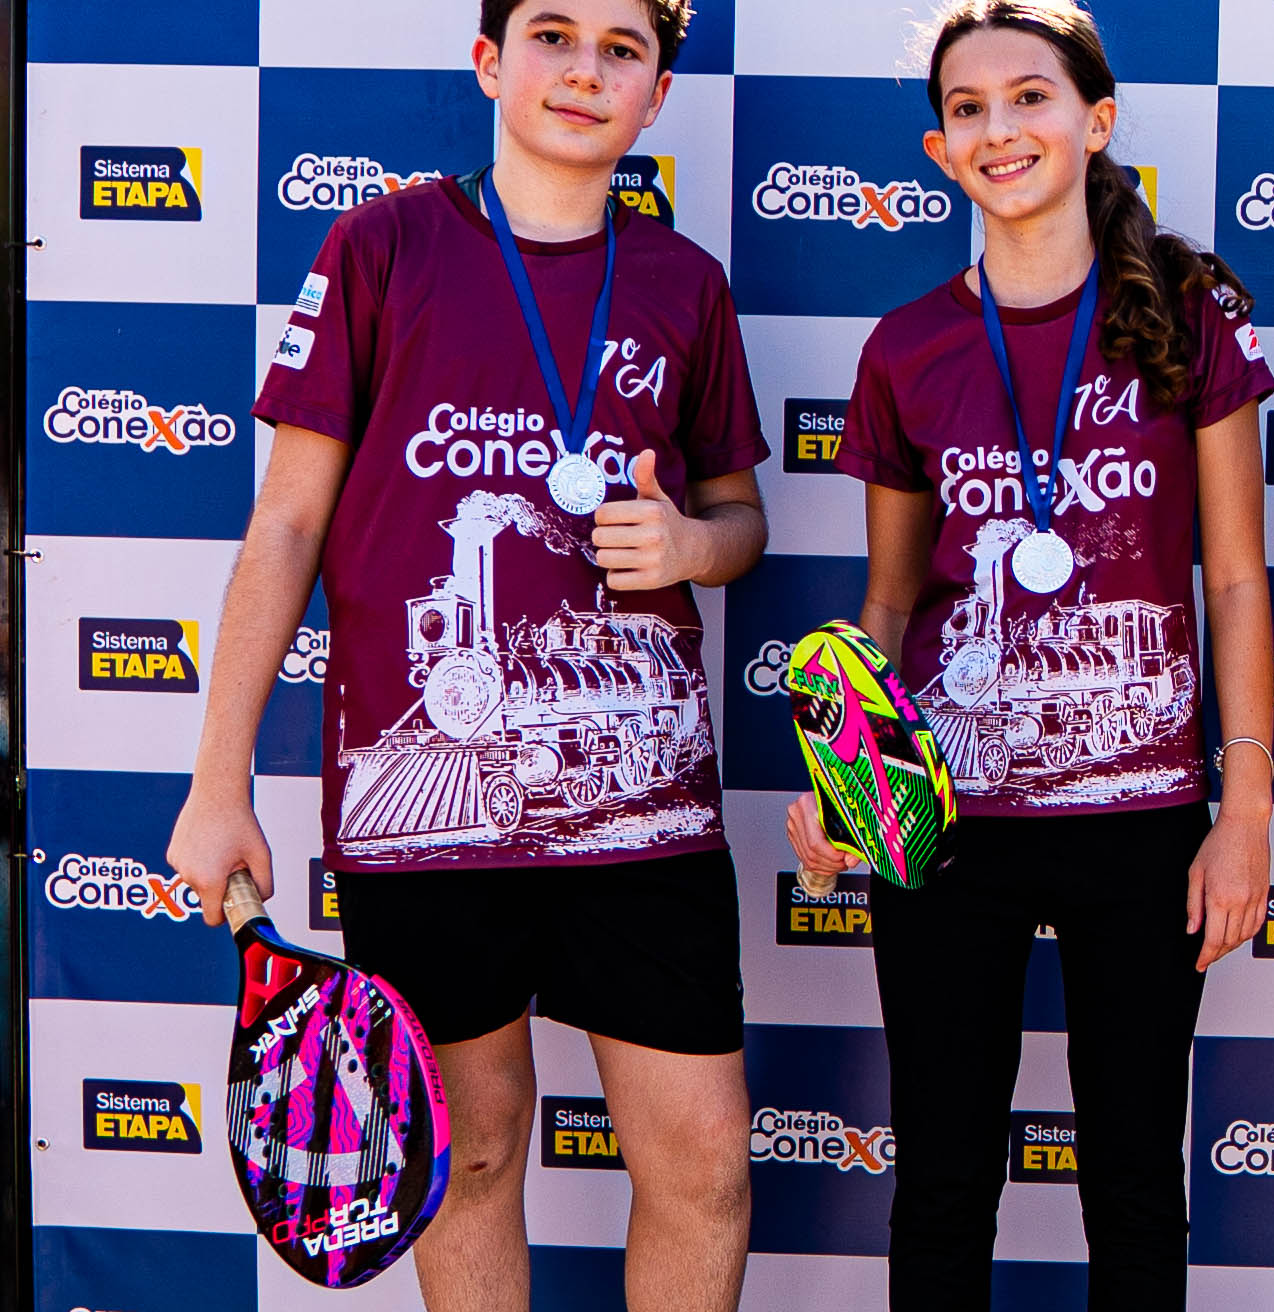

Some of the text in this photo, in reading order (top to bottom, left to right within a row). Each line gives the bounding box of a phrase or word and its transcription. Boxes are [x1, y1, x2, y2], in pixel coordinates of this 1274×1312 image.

[94, 160, 170, 178] Sistema
[297, 157, 378, 182] Colégio
[771, 165, 855, 190] Colégio
[93, 181, 188, 208] ETAPA
[282, 176, 423, 208] Cone
[62, 390, 142, 414] Colégio
[428, 403, 545, 440] Colégio
[798, 412, 844, 431] Siste
[405, 429, 642, 489] Coneã
[941, 445, 1049, 480] Colégo
[92, 631, 167, 651] Sistema
[91, 653, 185, 679] ETAPA
[63, 858, 143, 880] Colégio
[49, 874, 202, 917] ConeX
[248, 983, 320, 1064] SHARK
[96, 1092, 170, 1112] Sistema
[96, 1113, 188, 1141] ETAPA
[555, 1109, 612, 1128] Siste
[758, 1111, 841, 1137] Colégio
[555, 1131, 621, 1157] ETA
[1025, 1125, 1076, 1143] Siste
[750, 1129, 896, 1171] ConeX
[1024, 1146, 1078, 1171] ETA
